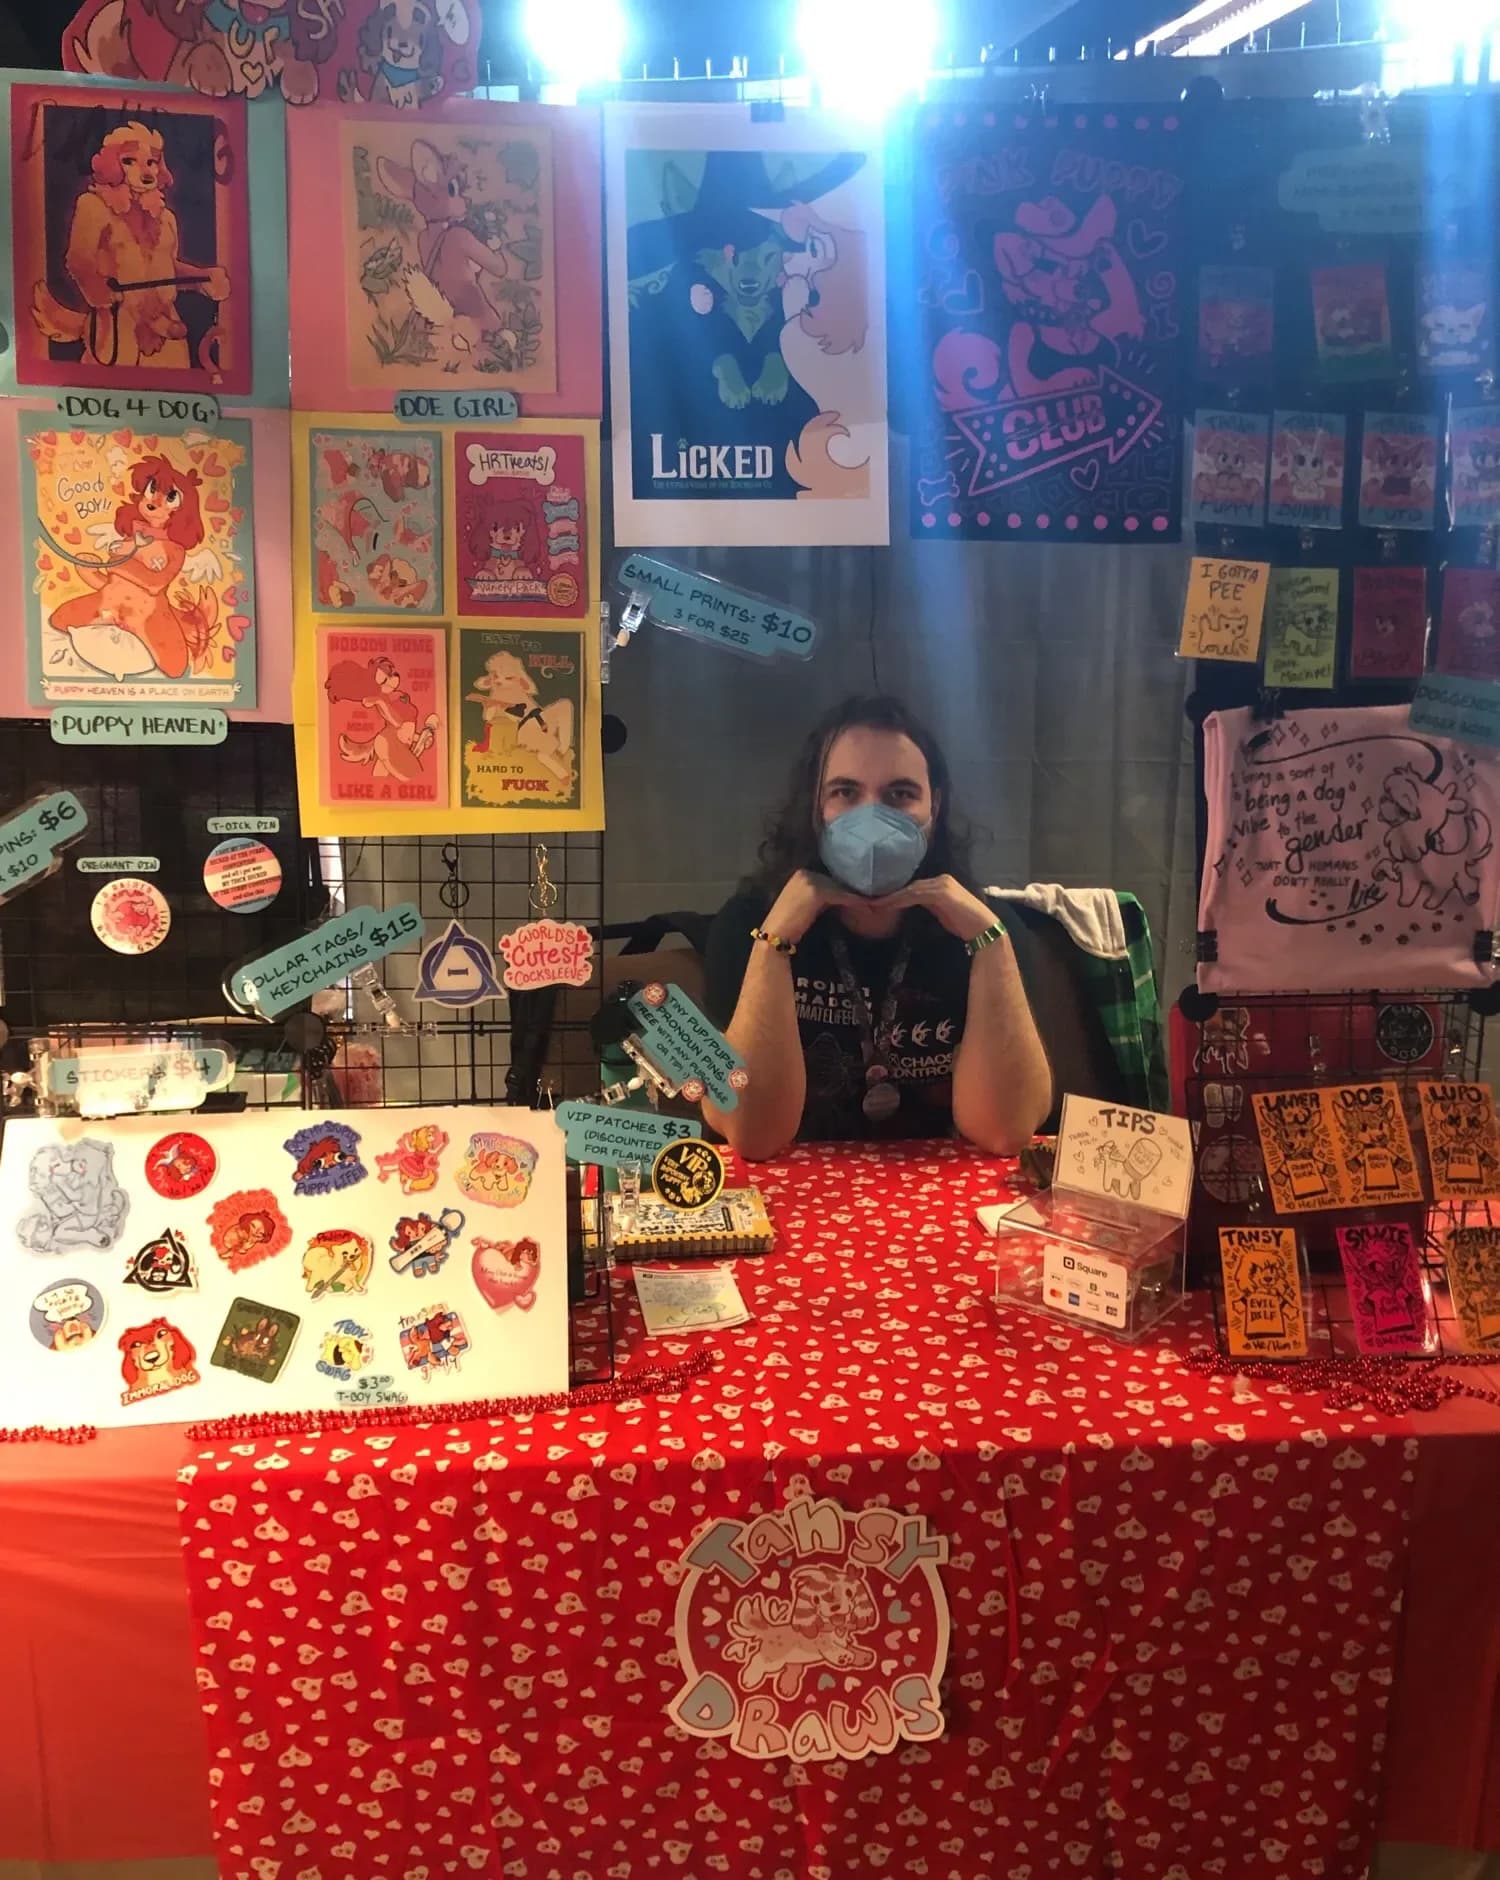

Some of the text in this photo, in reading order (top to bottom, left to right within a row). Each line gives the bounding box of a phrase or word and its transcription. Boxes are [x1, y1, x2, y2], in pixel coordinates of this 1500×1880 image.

[66, 396, 208, 422] DOG 4 DOG
[400, 397, 512, 418] DOE GIRL
[1003, 395, 1106, 460] CLUB
[1201, 563, 1259, 584] I GOTTA
[1209, 580, 1246, 600] PEE
[624, 564, 812, 644] SMALL PRINTS: $10
[673, 608, 750, 645] 3 FOR $25
[329, 636, 433, 653] NOBODY HOME
[54, 686, 230, 697] PUPPY HEAVEN IS A PLACE ON EARTH
[62, 716, 216, 737] PUPPY HEAVEN
[477, 765, 524, 774] HARD TO
[1276, 772, 1284, 781] a
[1290, 767, 1315, 780] sort
[1321, 762, 1335, 777] of
[338, 784, 436, 799] LIKE A GIRL
[502, 779, 549, 792] FUCK
[1297, 790, 1307, 801] a
[39, 801, 77, 831] $6
[257, 821, 277, 830] PIN
[1278, 823, 1290, 839] to
[1295, 811, 1317, 832] the
[1285, 815, 1368, 874] gender
[7, 854, 38, 877] $10
[137, 860, 157, 869] PIN
[1309, 860, 1359, 872] HUMANS
[311, 921, 364, 956] TAGS/
[518, 926, 575, 944] WORLD'S
[270, 911, 418, 1001] KEYCHAINS $15
[512, 941, 583, 967] Cutest
[656, 1007, 702, 1056] PRONOUN
[670, 997, 735, 1070] TINY PUP/PUPS
[635, 1001, 729, 1104] FREE WITH ANY PURCHASE
[657, 1043, 668, 1056] OR
[67, 1056, 211, 1085] STICKERS $4
[1341, 1088, 1384, 1107] DOG
[1429, 1086, 1482, 1103] LUPO
[568, 1111, 691, 1139] VIP PATCHES $3
[1099, 1109, 1156, 1135] TIPS
[584, 1130, 662, 1150] (DISCOUNTED
[585, 1144, 656, 1163] FOR FLAWS)
[680, 1146, 708, 1173] VIP
[1222, 1230, 1284, 1247] TANSY
[1077, 1262, 1108, 1278] Square
[1105, 1290, 1119, 1299] VISA
[1250, 1298, 1276, 1309] EVIL
[1252, 1340, 1291, 1351] He/Him
[315, 1360, 352, 1381] SWAG
[122, 1371, 196, 1406] IMMORAL DOG
[337, 1391, 371, 1404] T-BOY
